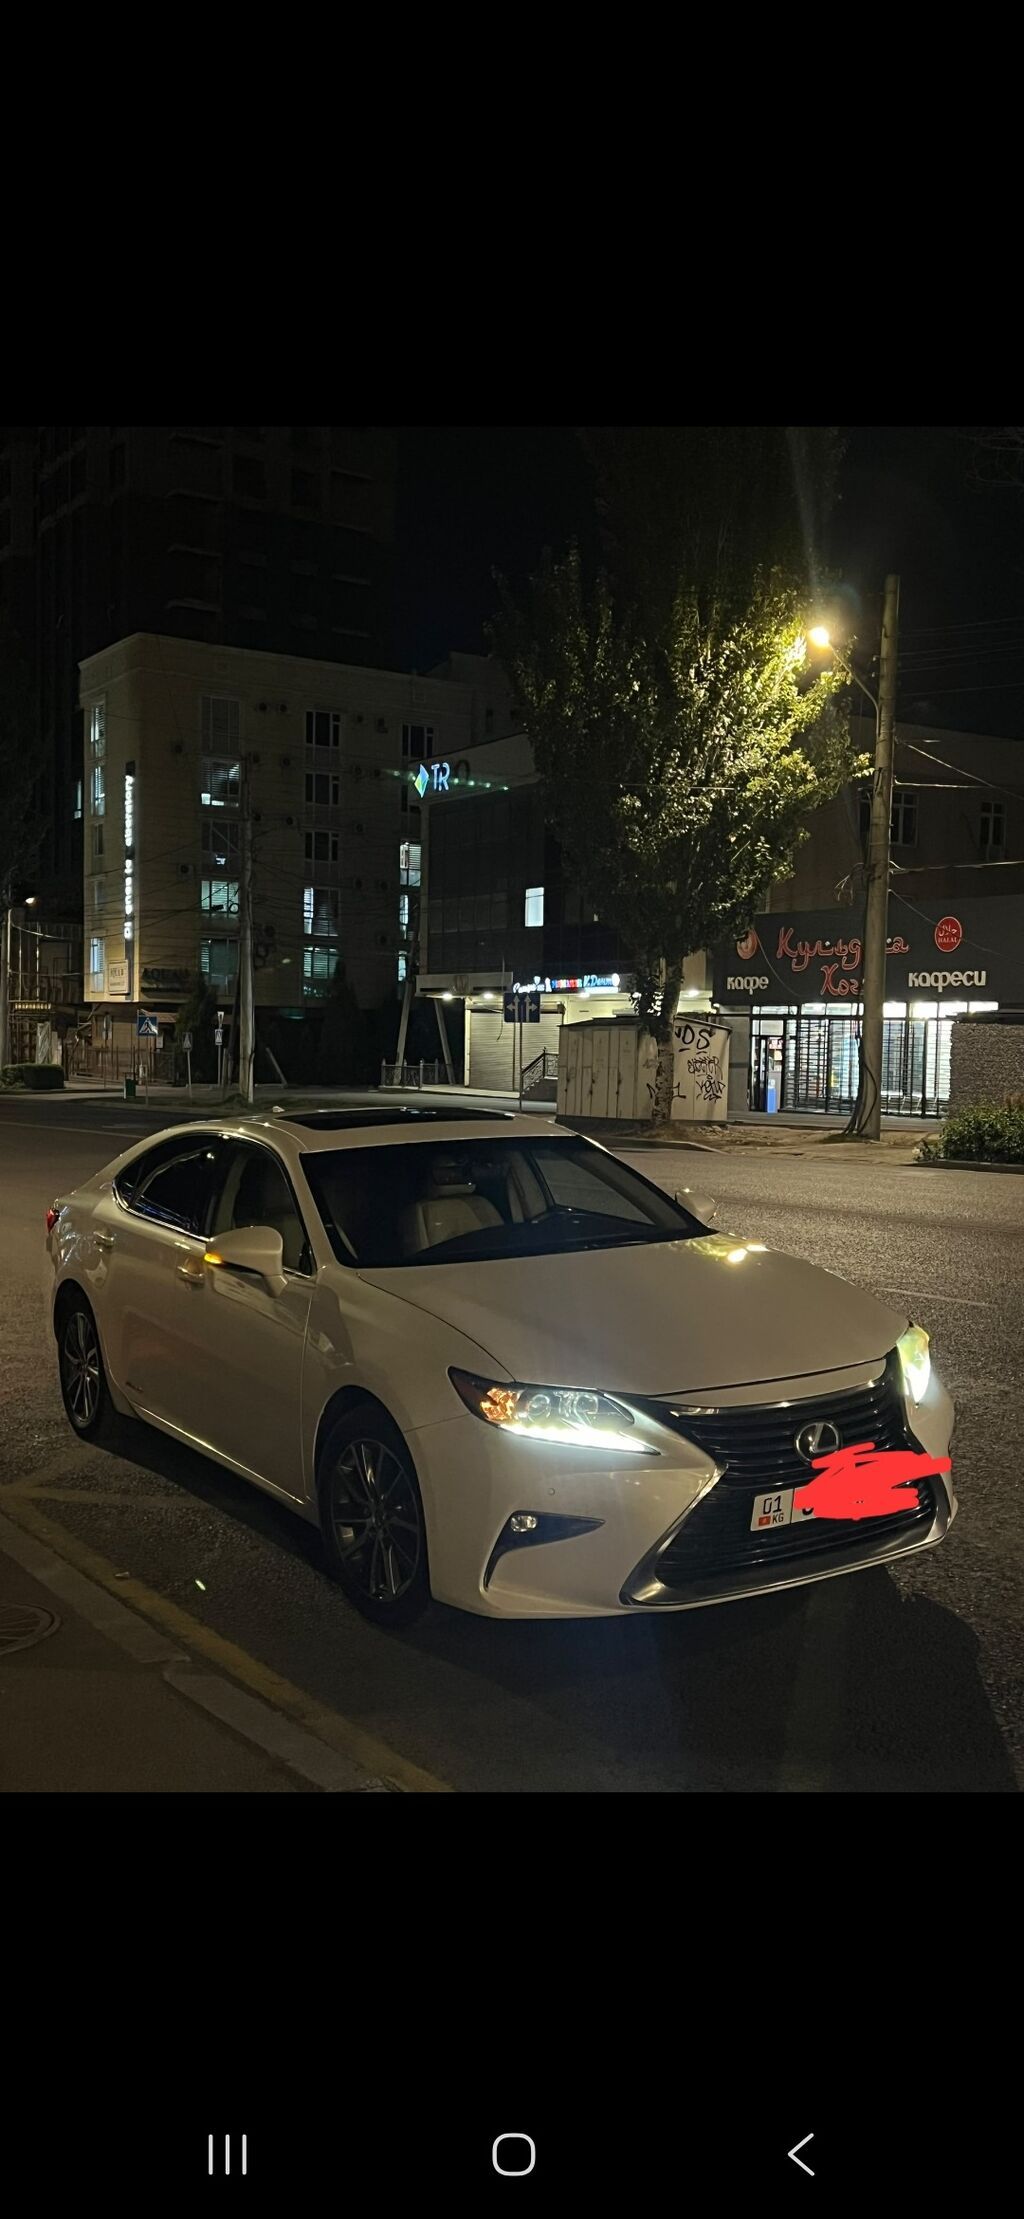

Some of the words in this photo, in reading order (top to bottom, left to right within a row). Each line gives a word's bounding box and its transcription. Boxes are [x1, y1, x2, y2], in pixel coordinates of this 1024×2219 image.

[125, 775, 134, 850] aboratory
[776, 926, 910, 972] Кульда
[726, 974, 770, 996] кафе
[819, 962, 866, 997] Хог
[908, 970, 987, 993] кафеси
[762, 1495, 782, 1514] 01
[771, 1513, 784, 1523] KG
